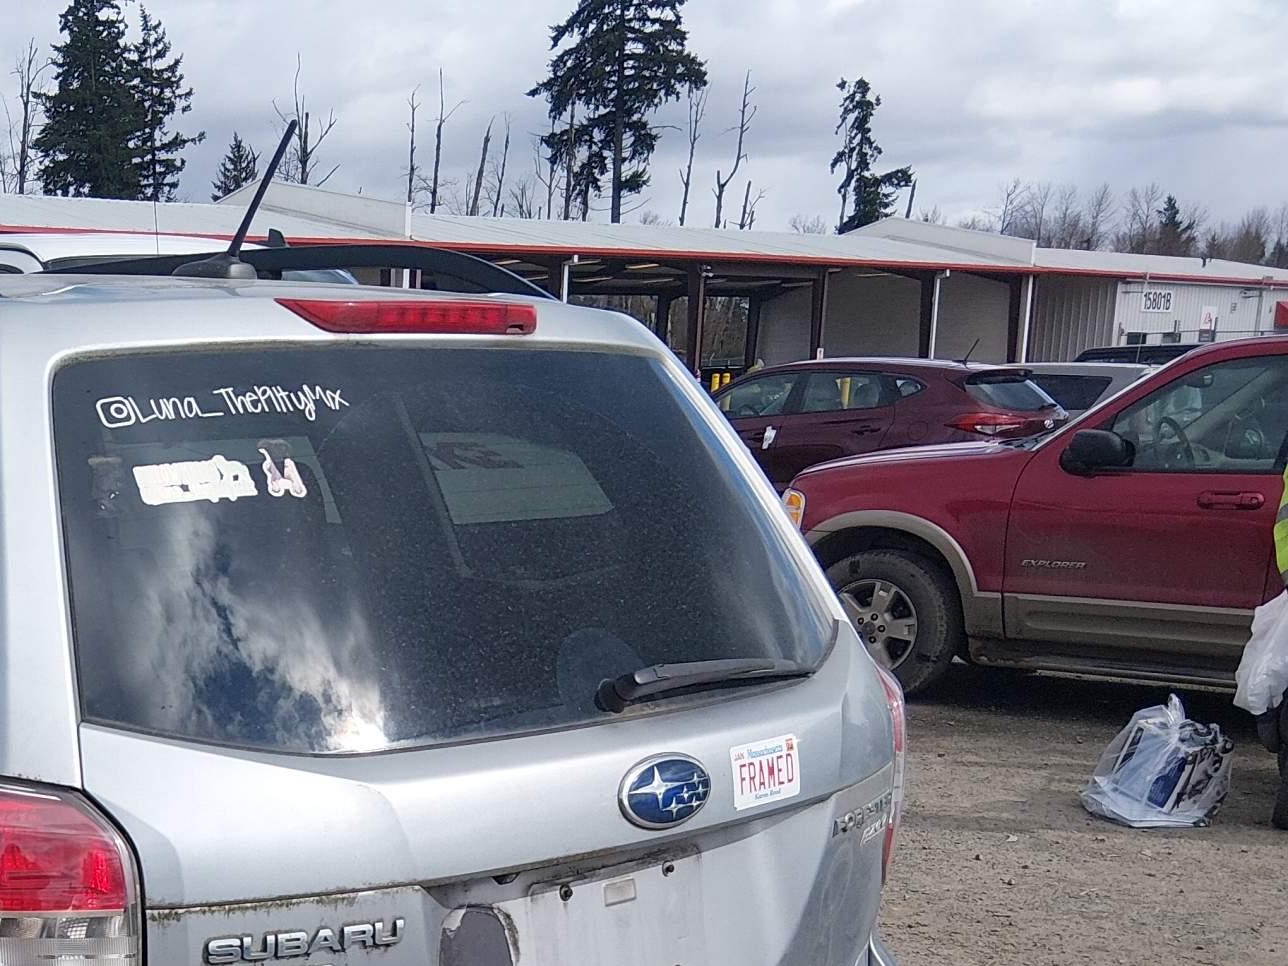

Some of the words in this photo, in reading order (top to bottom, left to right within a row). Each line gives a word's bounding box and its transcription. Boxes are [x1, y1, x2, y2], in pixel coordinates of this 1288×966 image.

[1143, 291, 1172, 311] 15801B
[1020, 559, 1087, 570] EXPLORER
[739, 752, 794, 796] FRAMED
[203, 917, 405, 965] SUBARU
